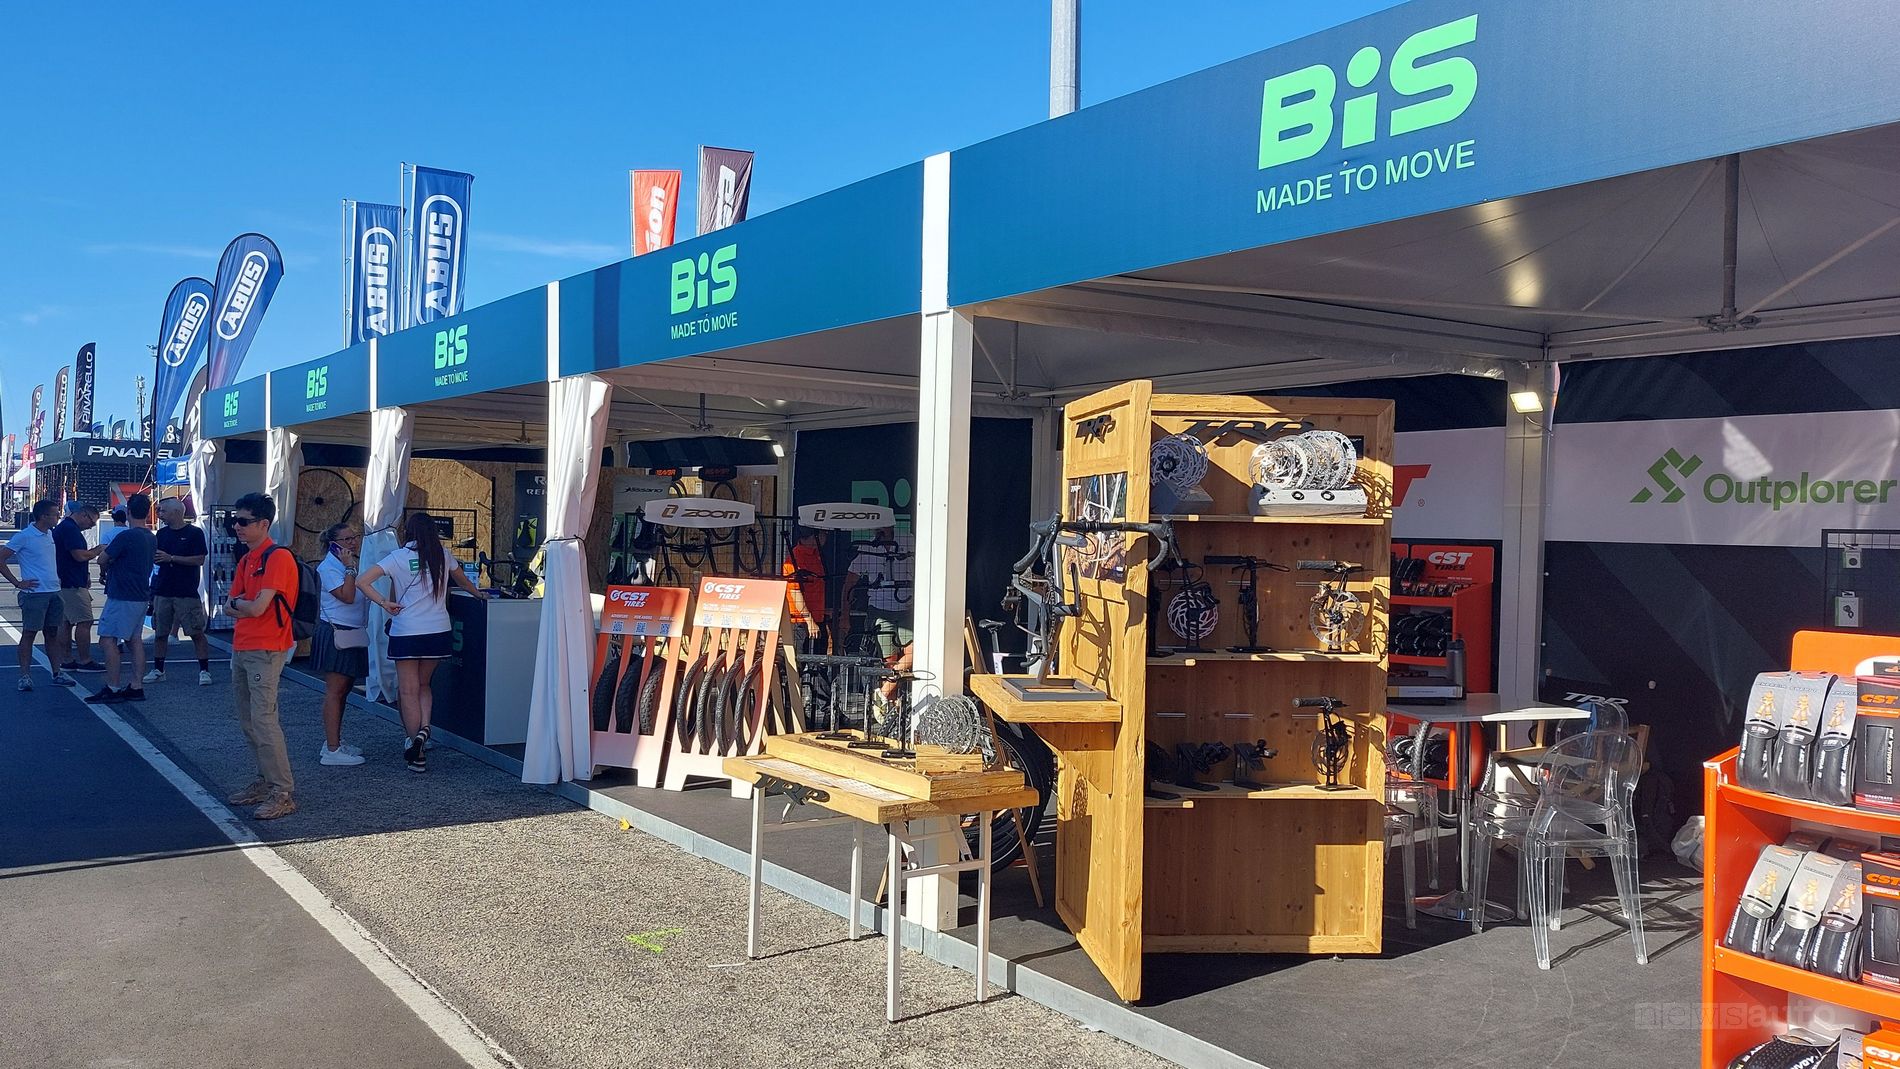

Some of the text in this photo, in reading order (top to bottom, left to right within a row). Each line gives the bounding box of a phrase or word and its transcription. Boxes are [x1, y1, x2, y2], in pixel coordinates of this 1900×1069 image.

[1256, 139, 1476, 214] MADE TO MOVE
[425, 211, 454, 316] ABUS
[224, 261, 263, 331] ABUS
[366, 242, 389, 337] ABUS
[172, 301, 204, 360] ABUS
[671, 312, 738, 340] MADE TO MOVE
[82, 351, 94, 424] PINARELLO
[88, 445, 177, 459] PINAREL
[1703, 471, 1898, 511] Outplorer
[1428, 551, 1473, 565] CST
[620, 591, 650, 601] CST
[624, 600, 646, 608] TIRES
[714, 584, 746, 594] CST
[1859, 694, 1899, 706] CST
